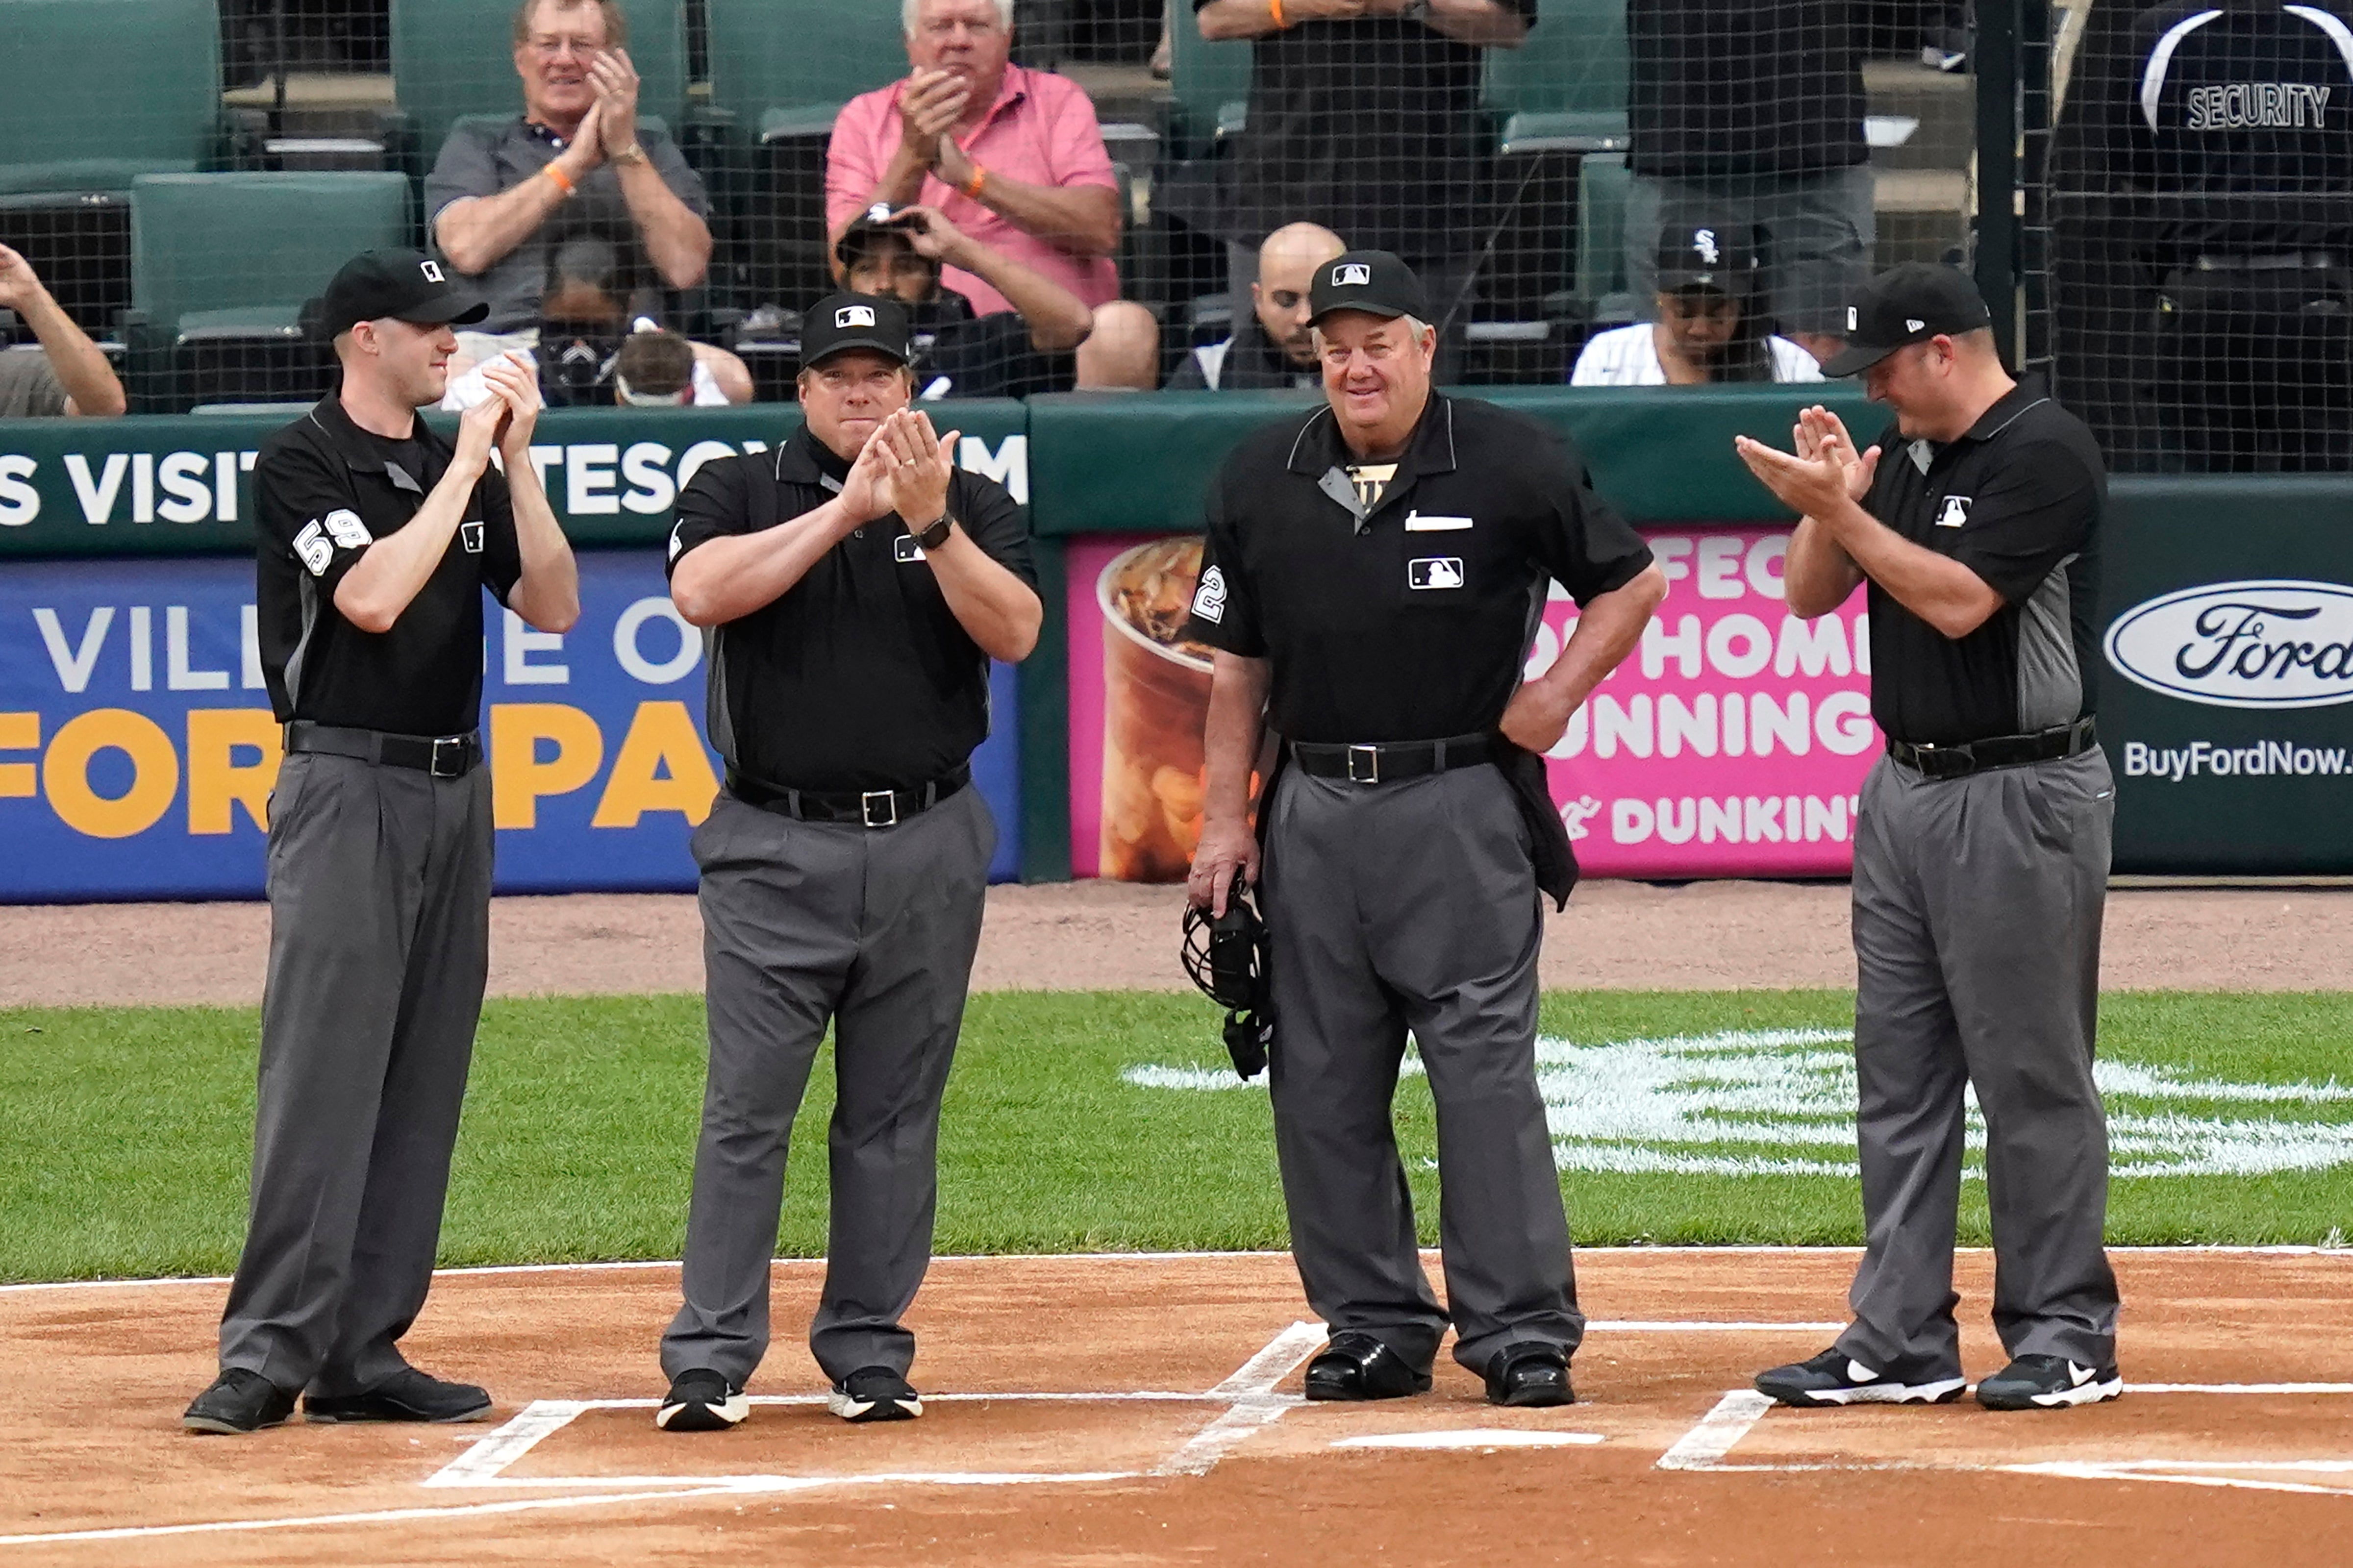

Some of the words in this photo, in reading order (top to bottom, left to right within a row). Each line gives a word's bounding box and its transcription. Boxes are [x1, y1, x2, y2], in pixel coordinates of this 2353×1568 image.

[2187, 83, 2330, 130] SECURITY
[293, 509, 373, 576] 59
[2176, 603, 2353, 680] Ford
[2124, 741, 2353, 782] BuyFordNow.
